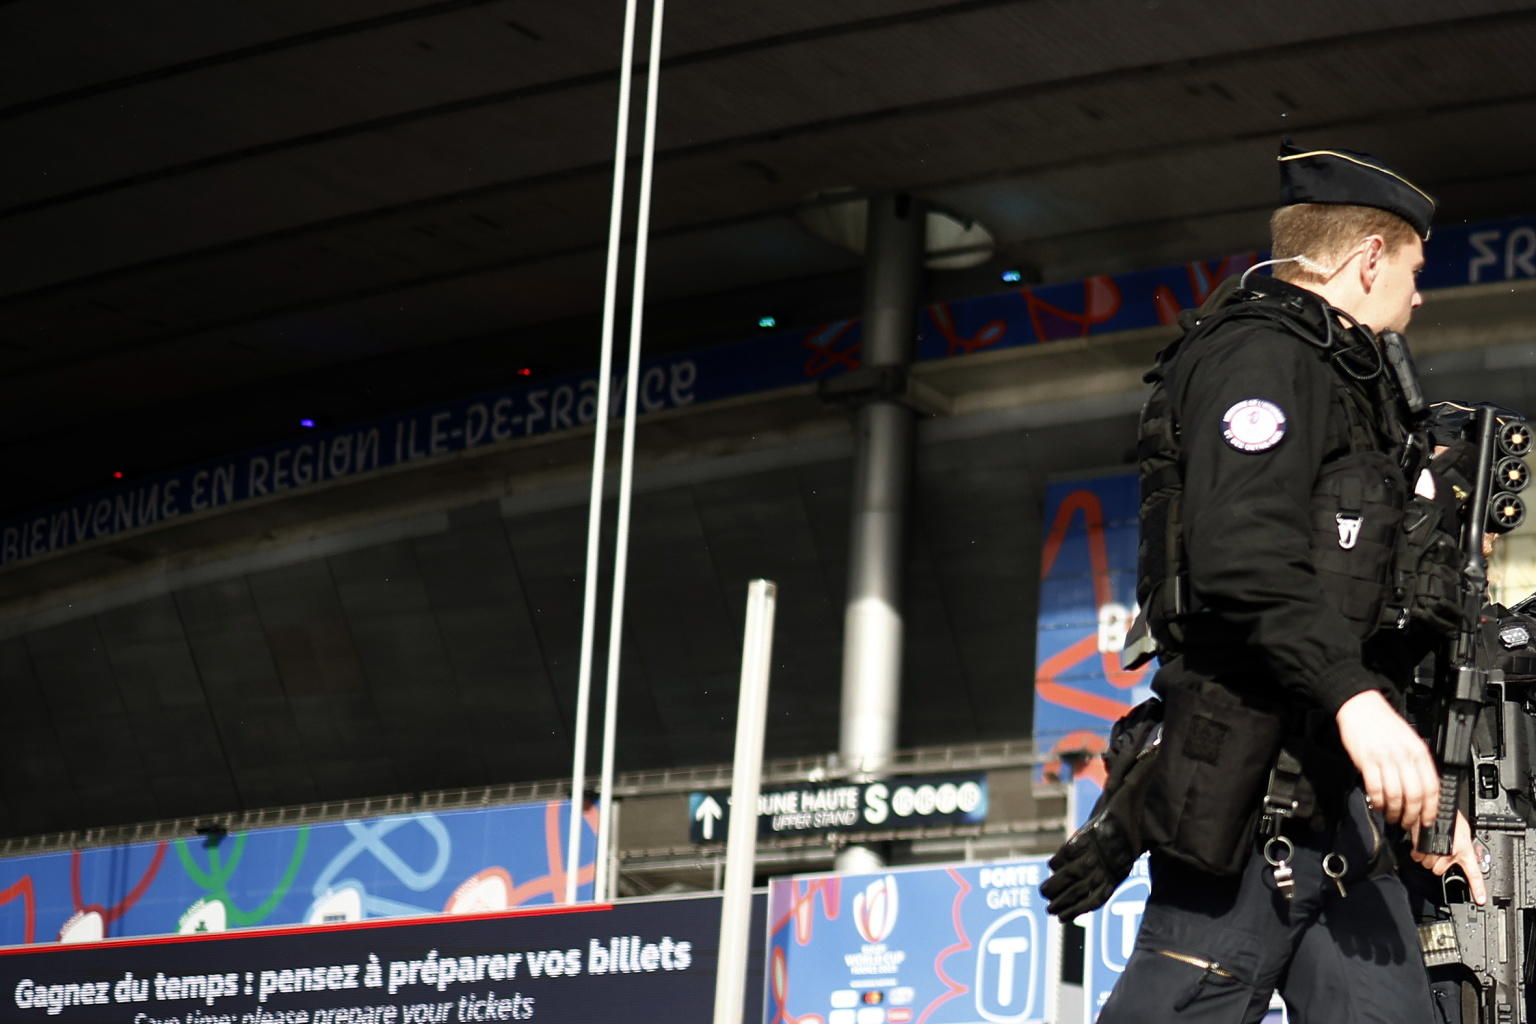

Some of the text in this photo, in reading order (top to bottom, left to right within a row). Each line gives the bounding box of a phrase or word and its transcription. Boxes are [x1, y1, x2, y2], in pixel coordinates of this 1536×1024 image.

[190, 462, 236, 511] EN
[801, 786, 859, 811] HAUTE
[863, 783, 889, 825] S
[812, 809, 860, 828] STAND
[979, 865, 1040, 889] PORTE
[986, 888, 1032, 910] GATE
[14, 978, 111, 1015] Gagnez
[114, 971, 150, 1003] du
[154, 972, 240, 1006] temps
[259, 963, 361, 1003] pensez
[363, 952, 383, 989] à
[388, 948, 523, 995] préparer
[526, 947, 583, 978] vos
[588, 935, 693, 976] billets
[987, 936, 1029, 1007] T
[458, 990, 536, 1024] tickets
